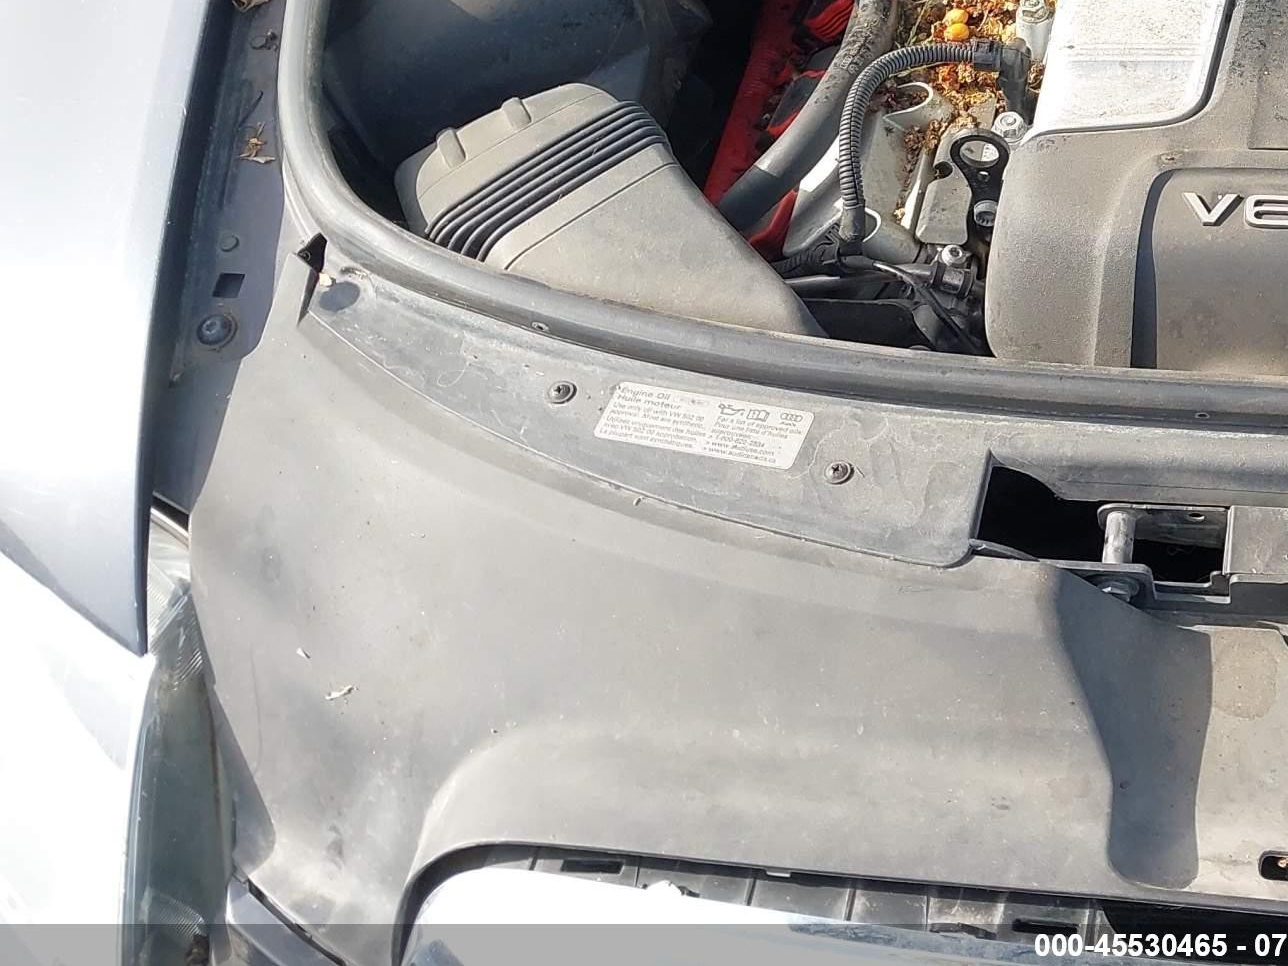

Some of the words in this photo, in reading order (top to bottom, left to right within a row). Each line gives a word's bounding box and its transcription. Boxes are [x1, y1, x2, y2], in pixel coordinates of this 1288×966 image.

[621, 387, 653, 398] Engine
[617, 395, 641, 403] Huile
[644, 400, 680, 409] moteur
